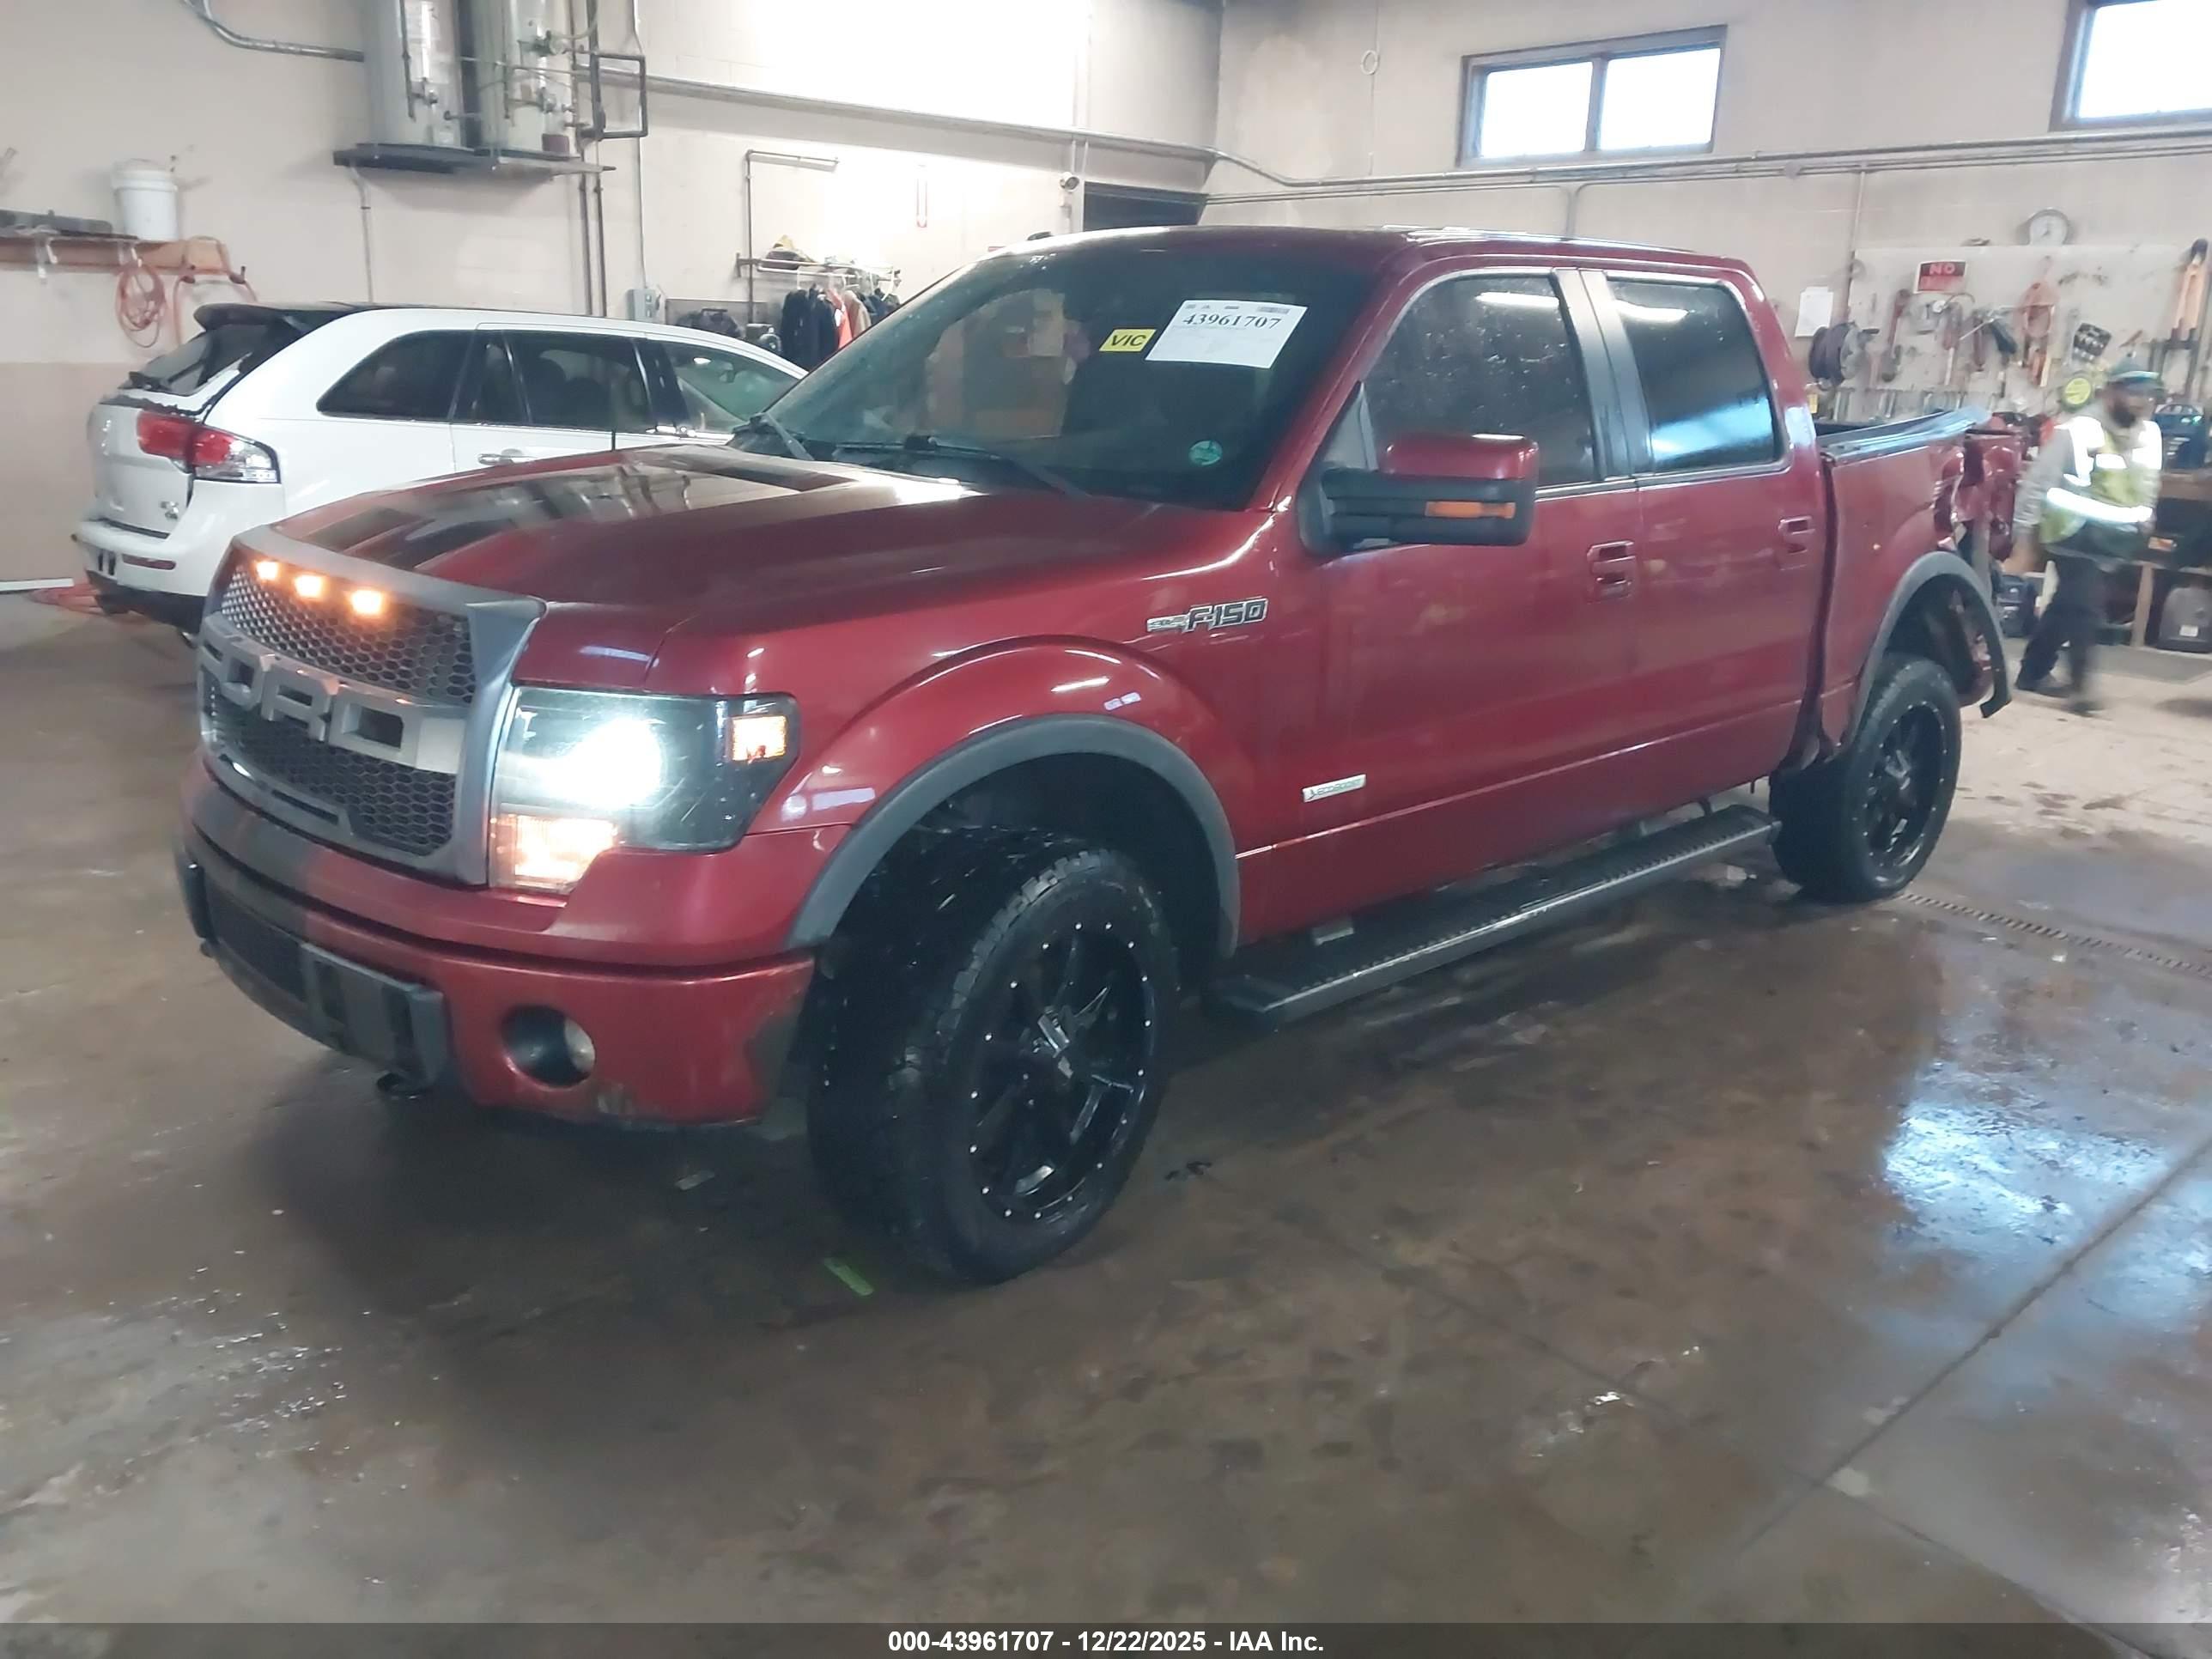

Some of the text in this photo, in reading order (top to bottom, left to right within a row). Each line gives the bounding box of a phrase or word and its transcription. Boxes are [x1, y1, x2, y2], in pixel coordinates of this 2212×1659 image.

[1929, 263, 1956, 275] NO
[1183, 313, 1282, 329] 43961707
[1110, 334, 1146, 347] VIC
[1183, 599, 1268, 633] F-150
